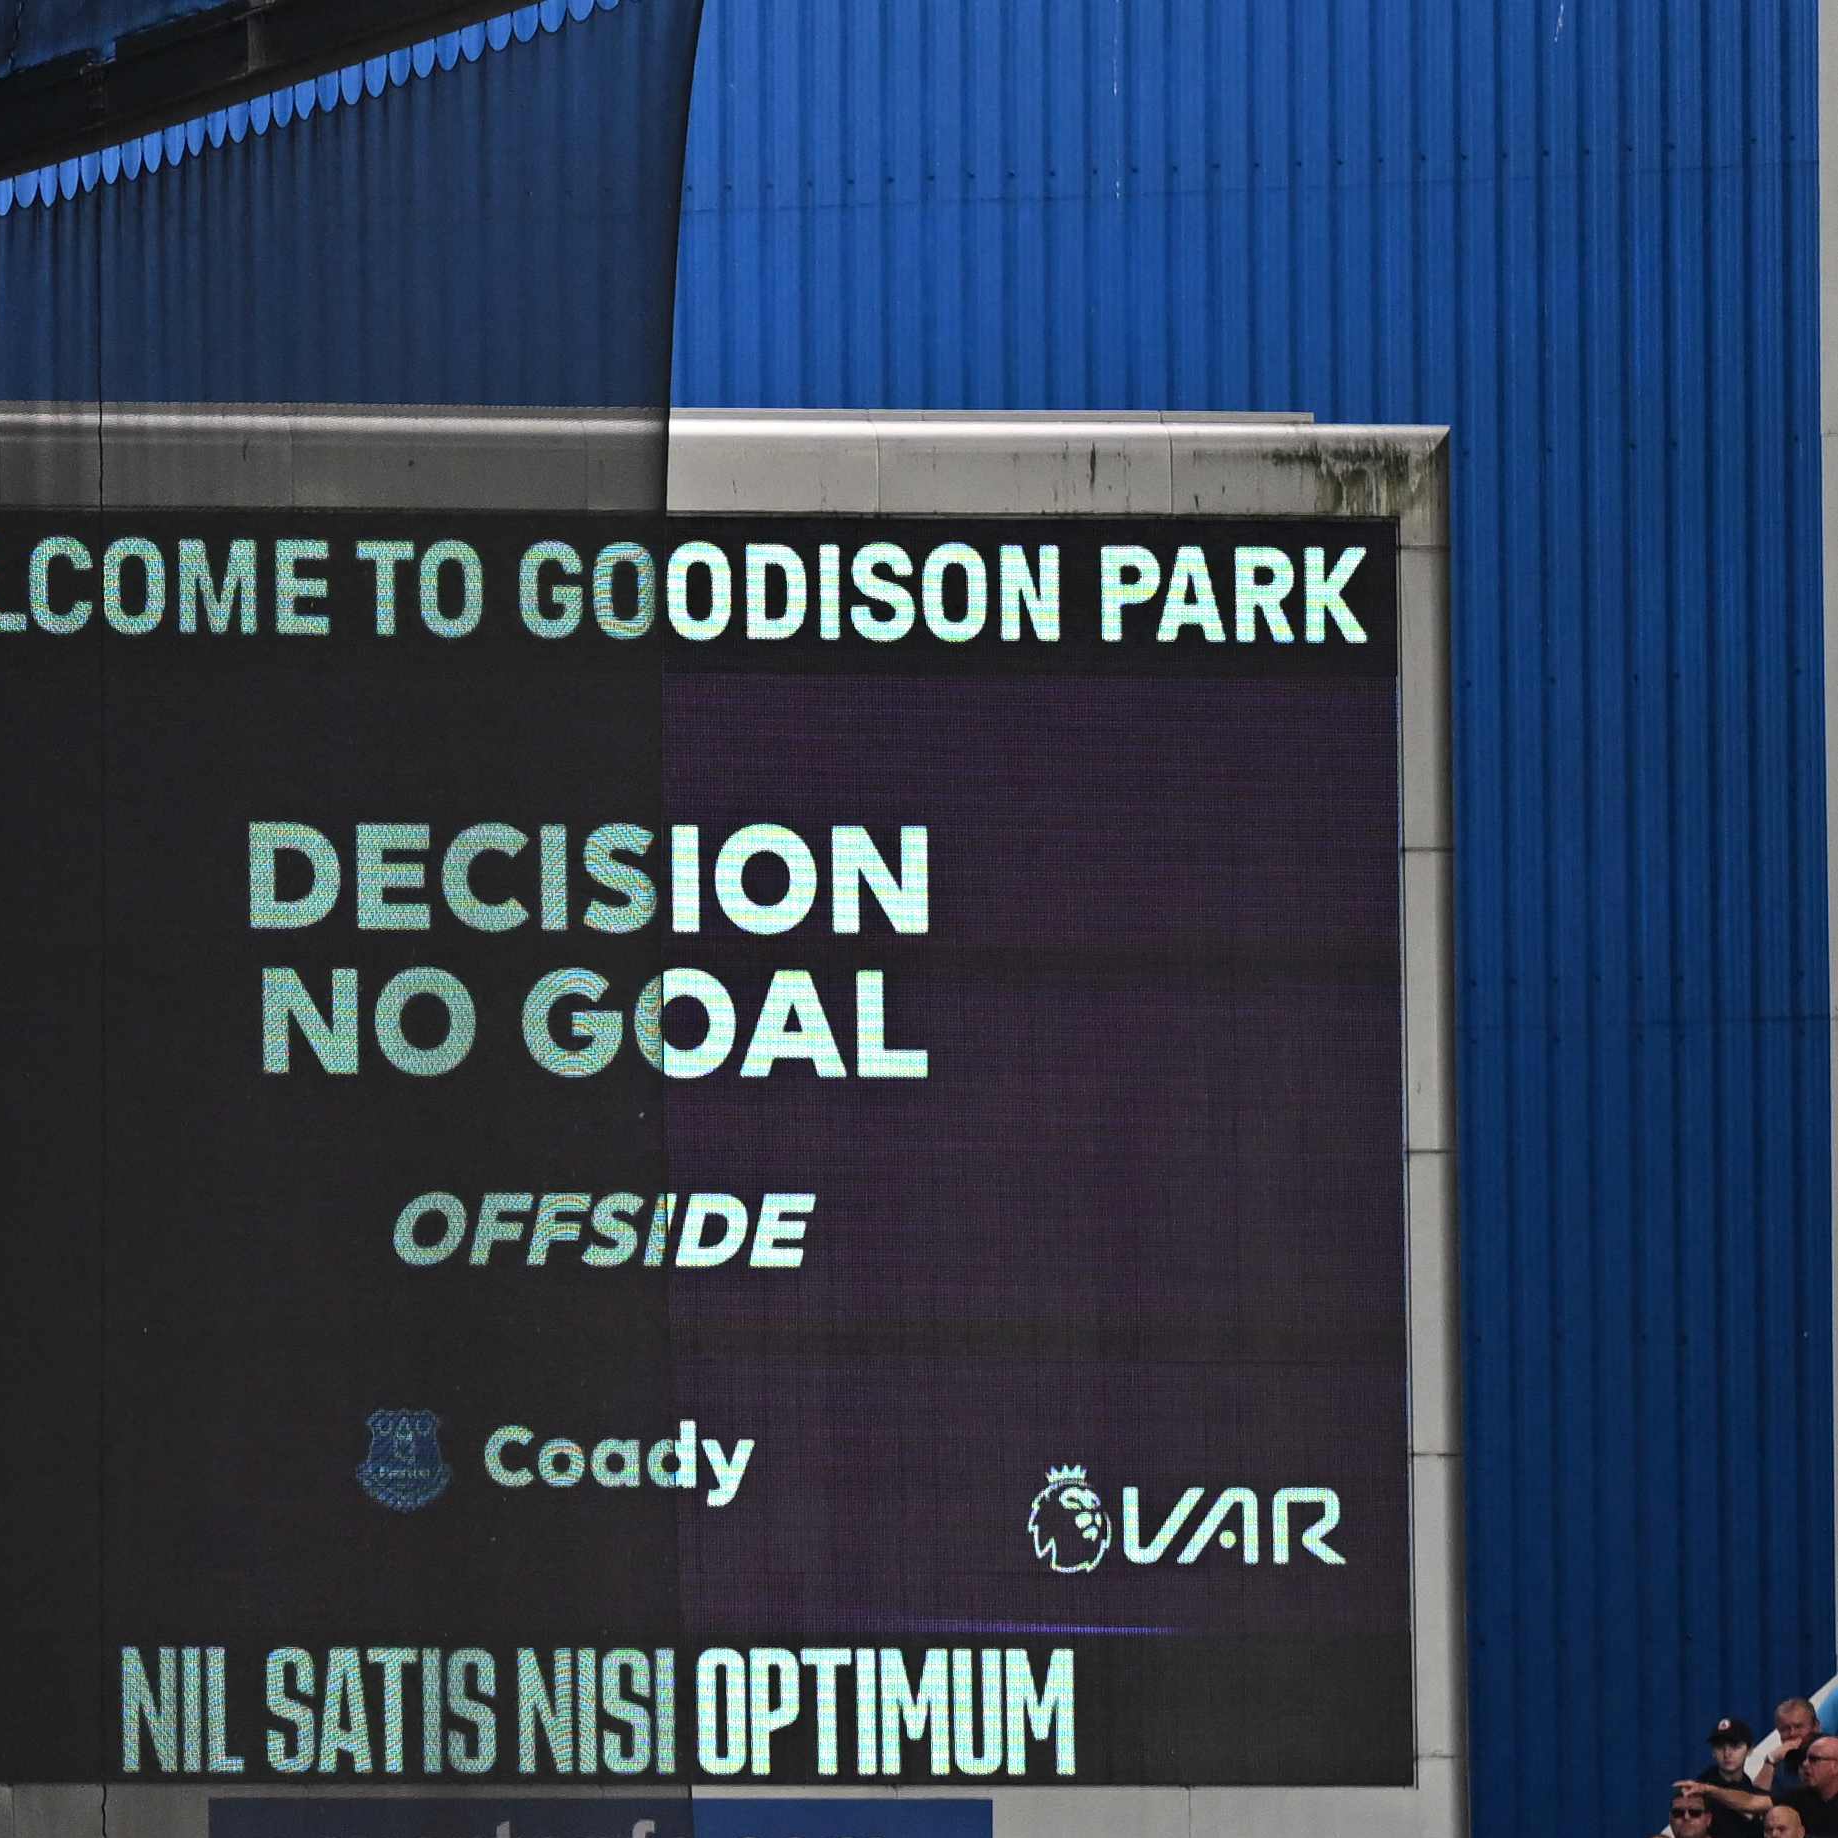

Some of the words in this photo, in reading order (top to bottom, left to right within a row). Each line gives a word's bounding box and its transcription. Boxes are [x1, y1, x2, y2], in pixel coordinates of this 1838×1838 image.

[356, 538, 483, 638] TO
[519, 540, 1061, 643] GOODISON
[1100, 544, 1368, 644] PARK
[249, 821, 929, 936] DECISION
[261, 966, 477, 1077] NO
[521, 967, 929, 1079] GOAL
[393, 1192, 817, 1268] OFFSIDE
[484, 1419, 755, 1507] Coady
[1122, 1486, 1346, 1565] VAR
[121, 1646, 245, 1773] NIL
[265, 1646, 497, 1774] SATIS
[516, 1647, 676, 1775] NISI
[696, 1647, 1076, 1776] OPTIMUM
